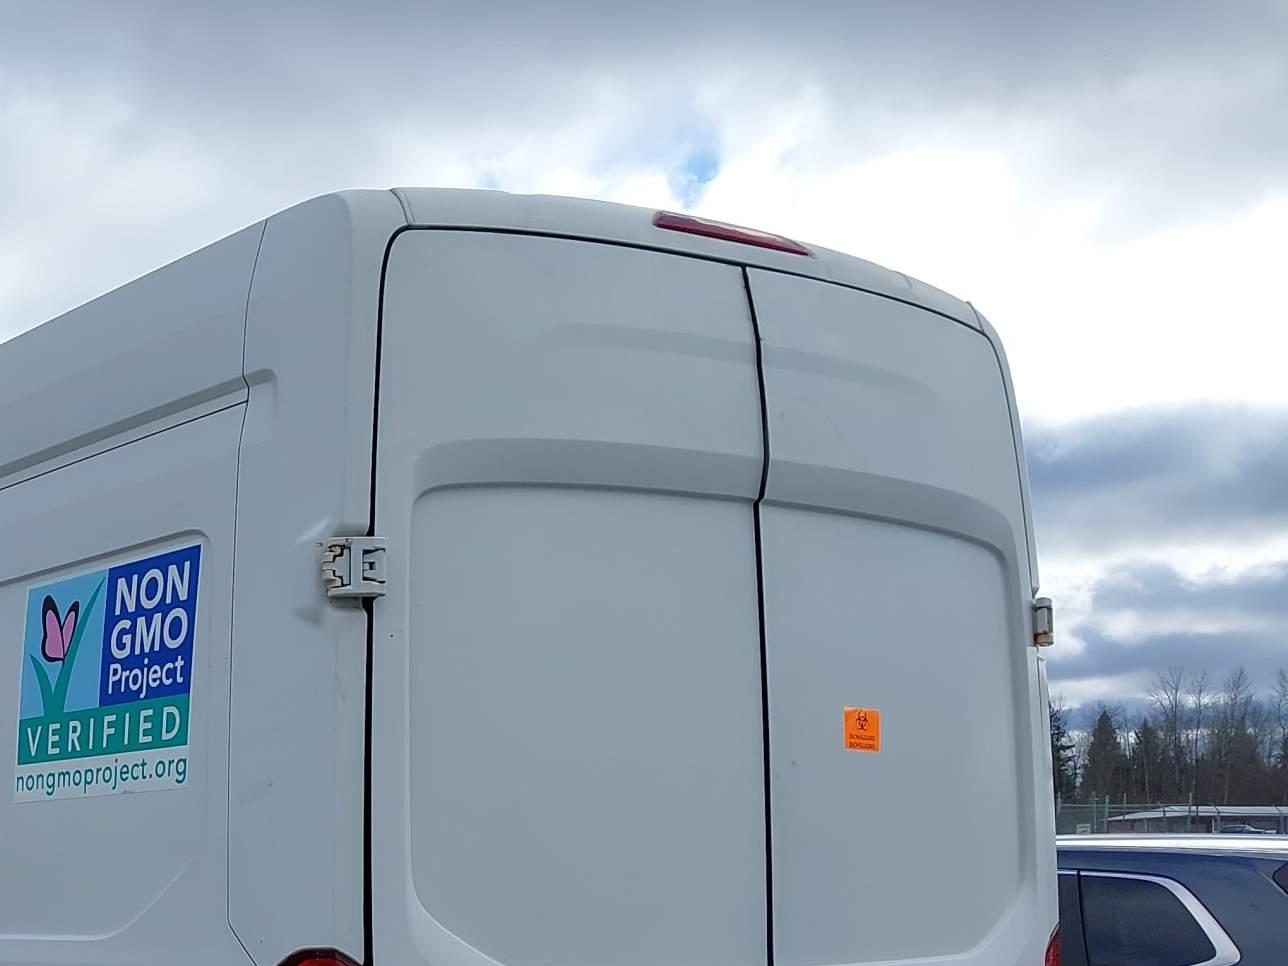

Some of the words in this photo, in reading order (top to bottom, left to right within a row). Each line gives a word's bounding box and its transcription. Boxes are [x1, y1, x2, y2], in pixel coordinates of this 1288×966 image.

[115, 560, 191, 616] NON
[111, 607, 189, 660] GMO
[108, 655, 185, 699] Project
[26, 705, 182, 757] VERIFIED
[16, 757, 188, 796] nongmoproject.org
